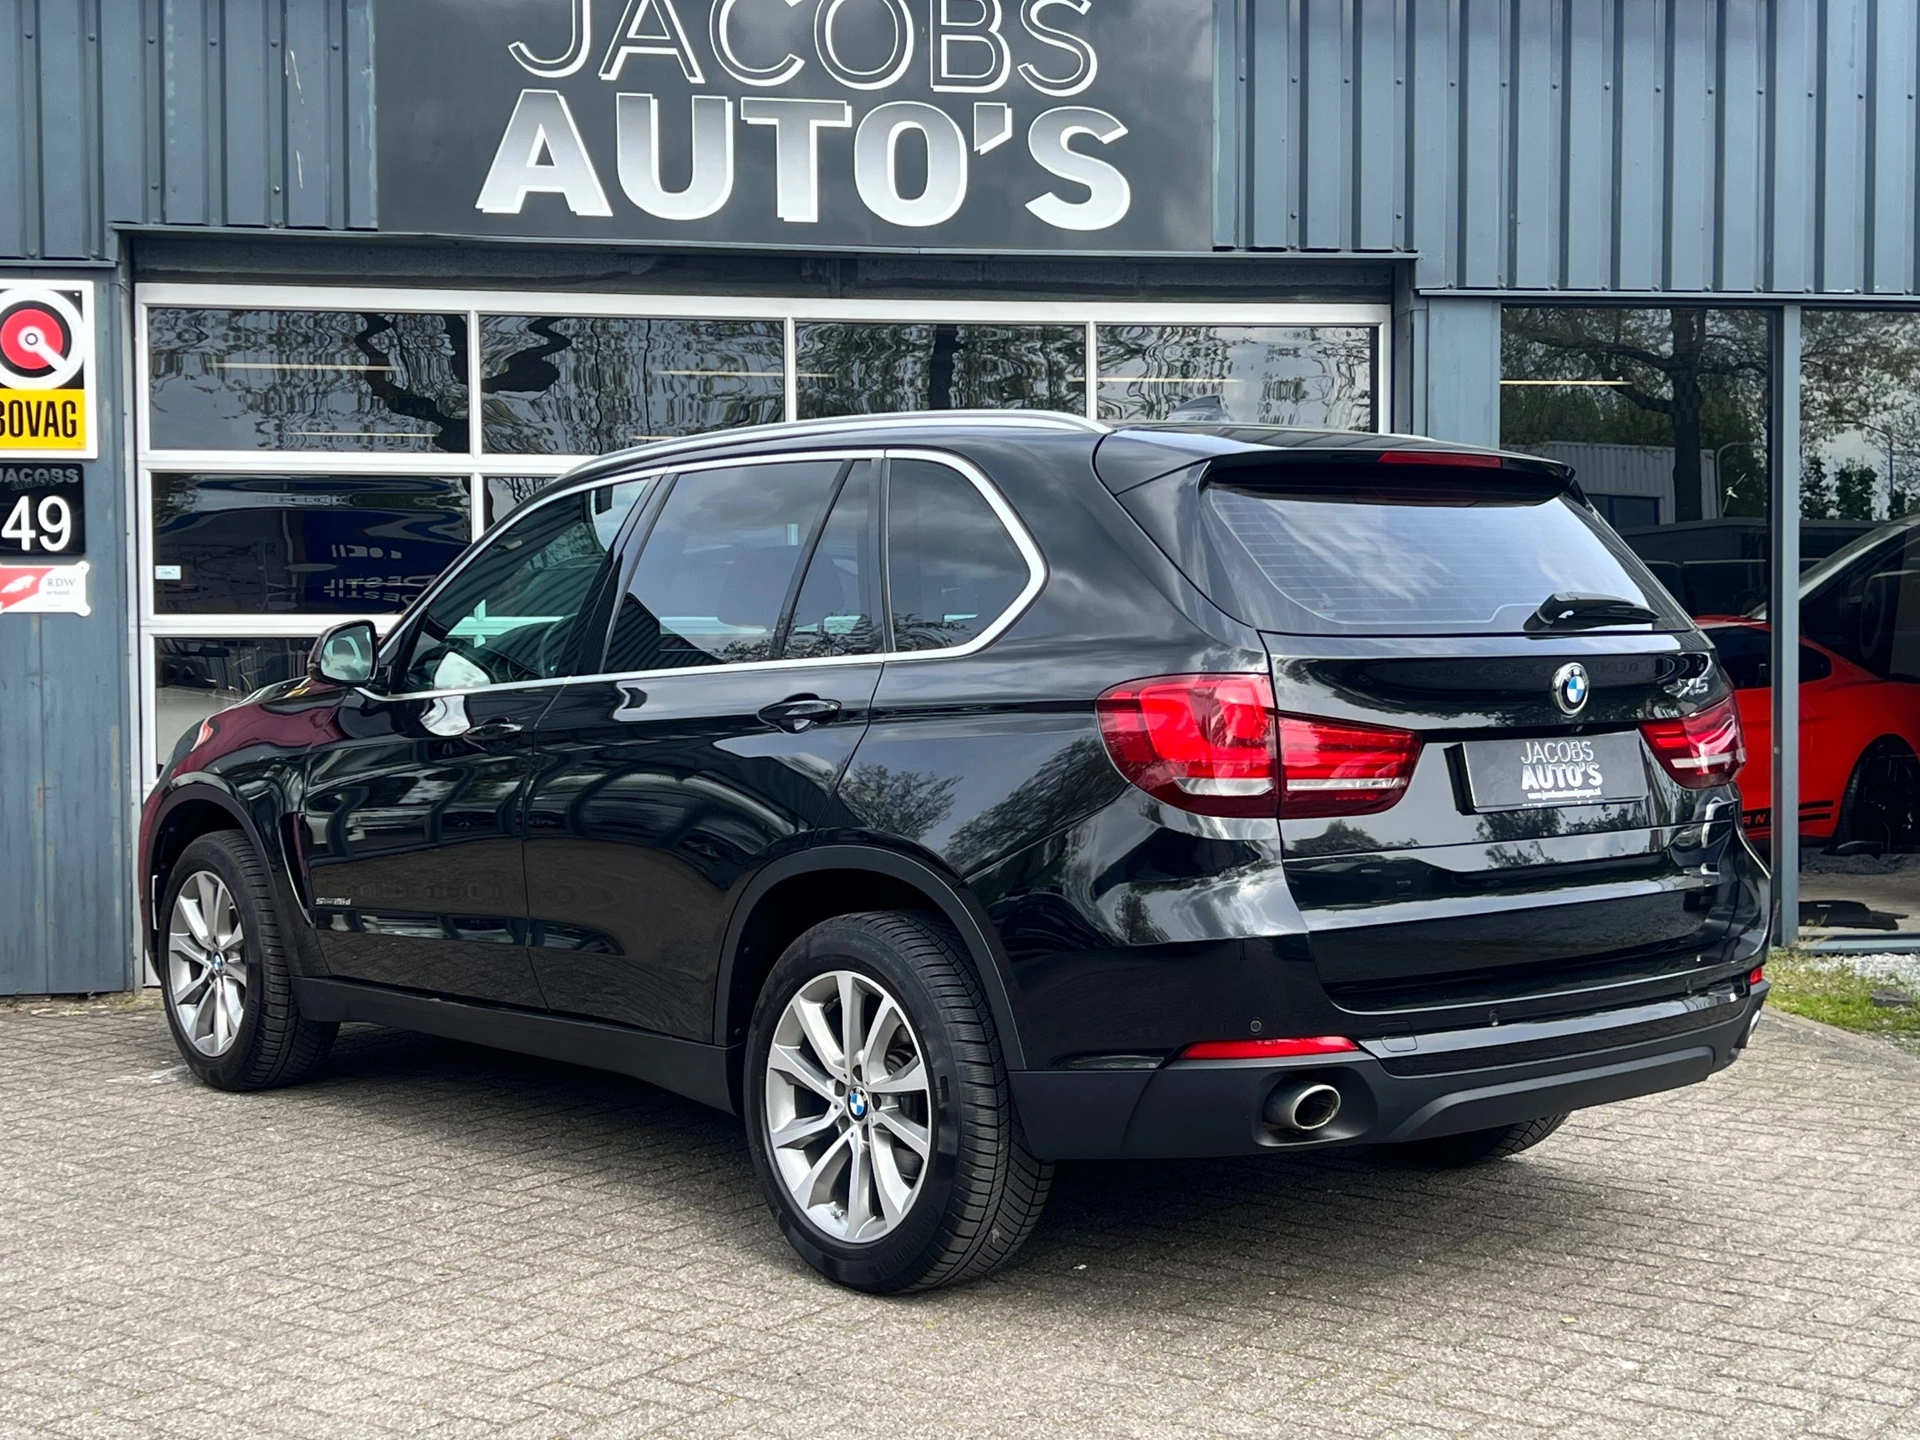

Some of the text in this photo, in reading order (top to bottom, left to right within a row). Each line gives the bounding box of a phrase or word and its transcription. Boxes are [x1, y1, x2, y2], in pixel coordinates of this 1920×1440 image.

[507, 0, 1098, 96] JACOBS
[476, 89, 1131, 231] AUTO'S
[0, 468, 79, 483] ACOBS
[0, 496, 71, 551] 49
[1520, 741, 1594, 764] JACOBS
[1521, 762, 1603, 790] AUTO'S
